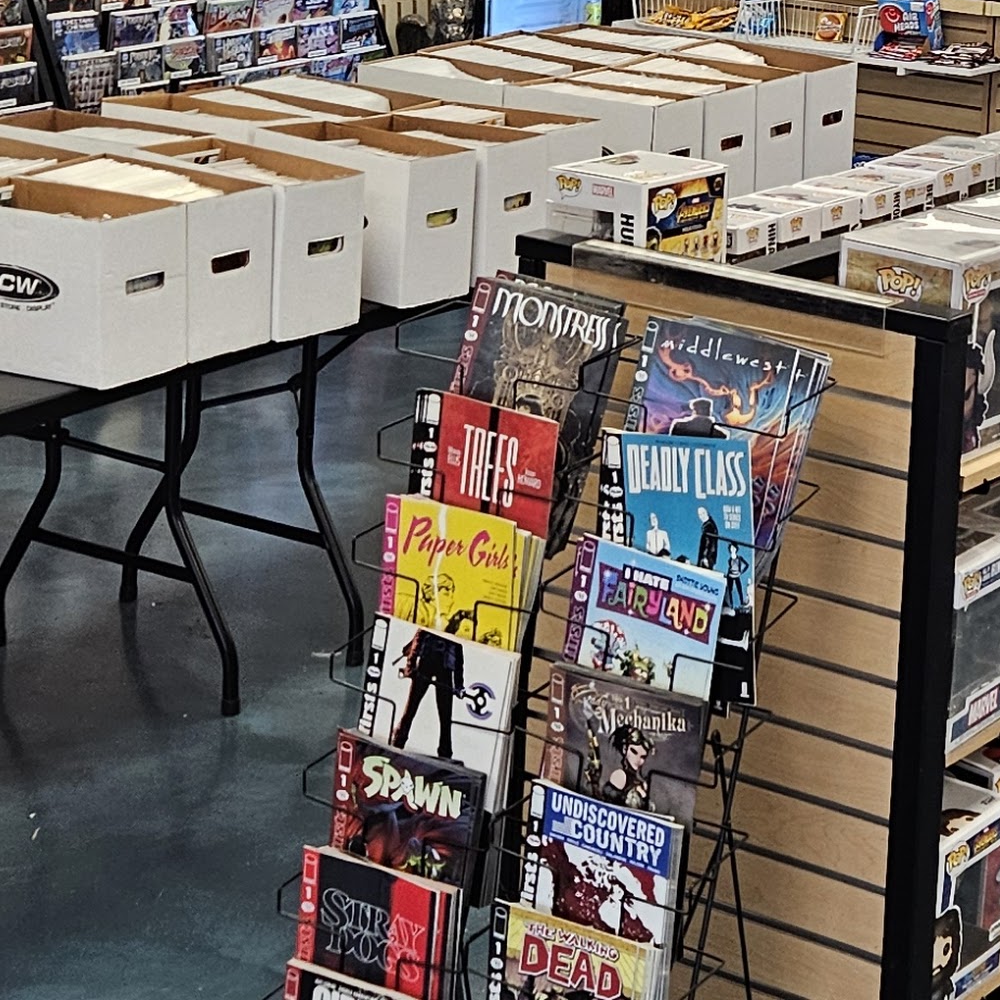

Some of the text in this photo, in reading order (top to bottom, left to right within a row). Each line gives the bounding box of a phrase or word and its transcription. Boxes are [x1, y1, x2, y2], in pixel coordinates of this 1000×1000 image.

[894, 22, 920, 33] HEADS
[902, 12, 919, 22] AIR
[0, 273, 41, 296] CW
[876, 266, 923, 297] POP!
[492, 288, 611, 351] MONSTRESS
[661, 335, 788, 373] middlewest
[460, 423, 519, 508] TREES
[627, 443, 747, 499] DEADLY CLASS
[403, 515, 510, 570] Paper Girls
[601, 570, 709, 635] FAIRYLAND
[624, 567, 670, 591] I HATE
[598, 706, 687, 735] Mechanika
[362, 756, 463, 819] SPAWN
[551, 791, 666, 848] UNDISCOVERED
[572, 817, 663, 867] COUNTRY
[320, 887, 426, 951] STRAY
[526, 921, 620, 962] THE WALKING
[325, 924, 420, 983] DOGS
[518, 932, 623, 1000] DEAD
